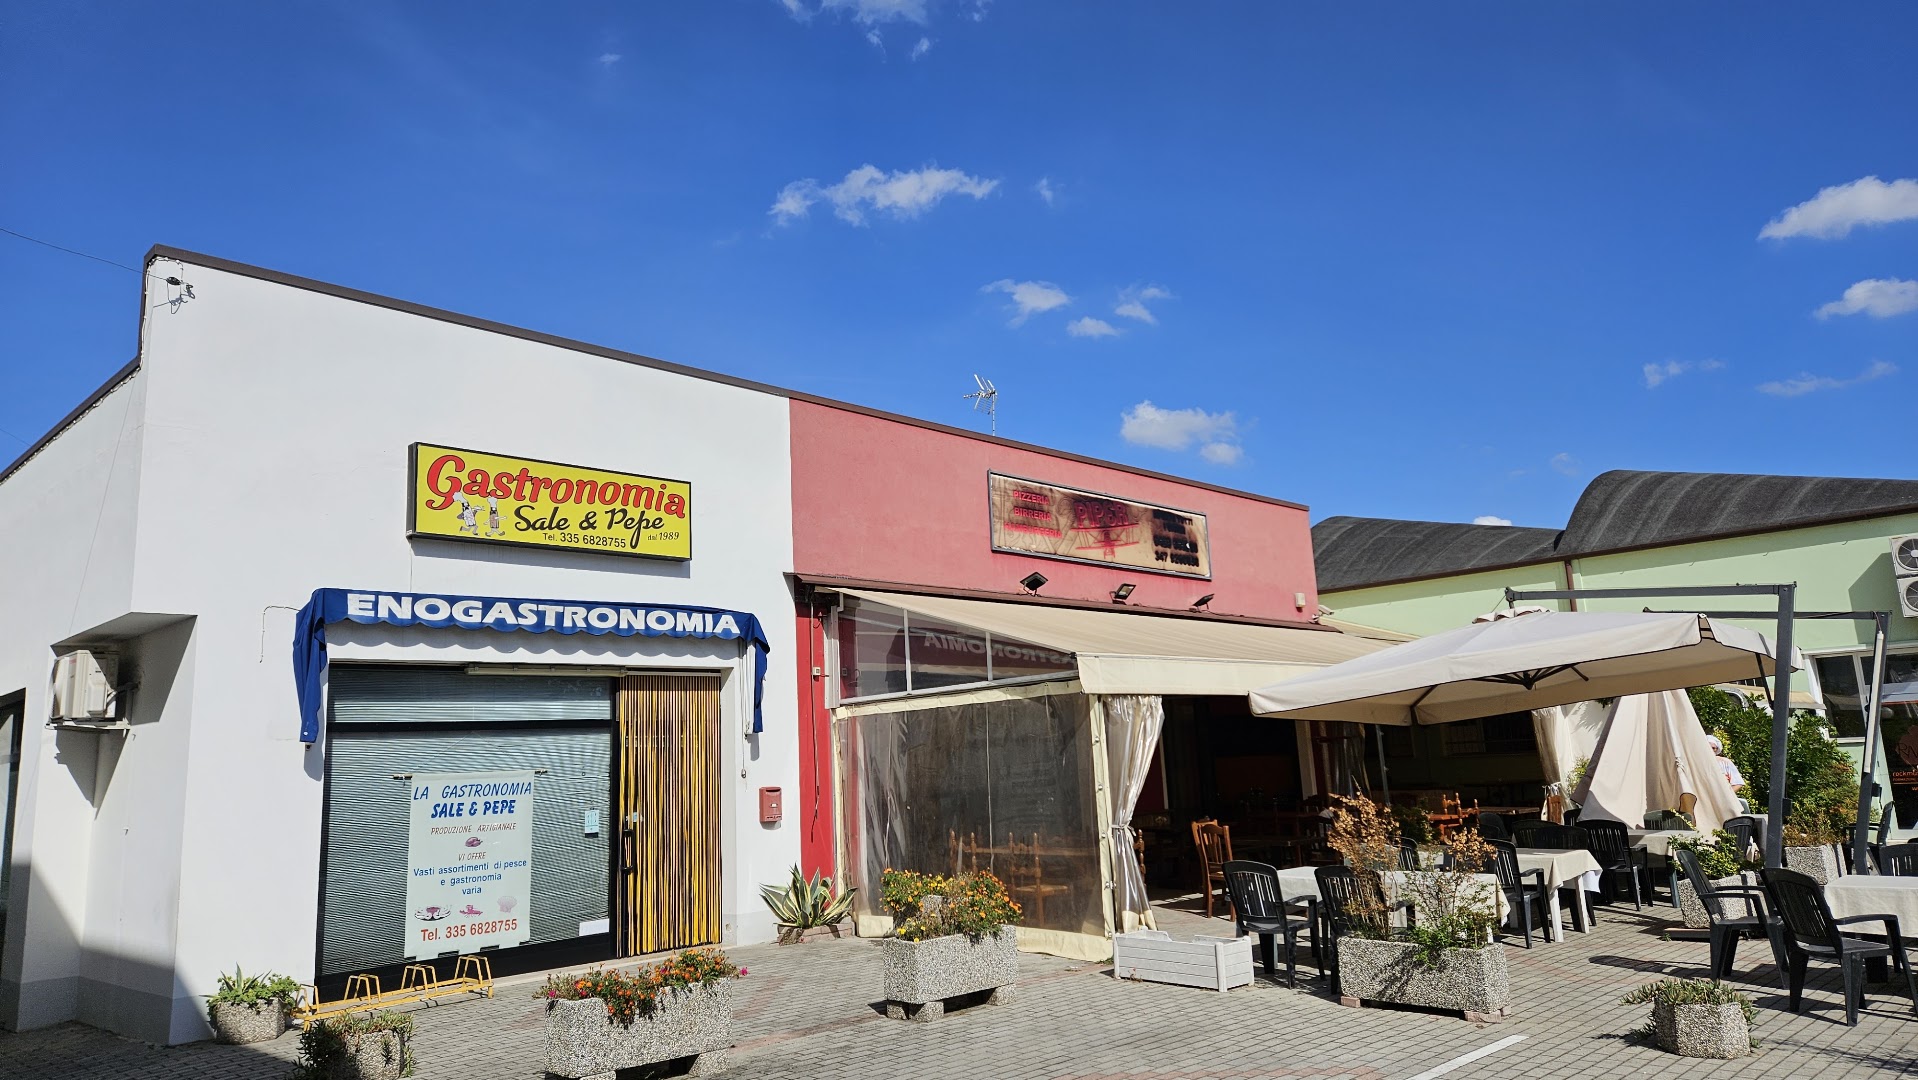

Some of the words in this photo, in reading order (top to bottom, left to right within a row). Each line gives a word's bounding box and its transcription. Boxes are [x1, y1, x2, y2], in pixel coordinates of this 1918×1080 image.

[425, 454, 686, 519] Gastronomia
[1013, 490, 1050, 505] PIZZERIA
[1013, 506, 1052, 521] BIRRERIA
[514, 505, 570, 532] Sale
[578, 510, 597, 531] &
[604, 507, 665, 549] Pepe
[543, 533, 557, 542] Tel.
[560, 532, 579, 543] 335
[583, 534, 626, 548] 6828755
[658, 531, 680, 541] 1989
[346, 593, 741, 635] ENOGASTRONOMIA
[413, 786, 429, 801] LA
[442, 782, 532, 799] GASTRONOMIA
[430, 802, 464, 819] SALE
[468, 801, 478, 817] &
[483, 800, 516, 815] PEPE
[431, 825, 472, 836] PRODUZIONE
[477, 822, 516, 833] ARTIGIANALE
[458, 853, 465, 862] VI
[467, 852, 487, 861] OFFRE
[413, 867, 435, 877] Vasti
[438, 862, 489, 875] assortimenti
[493, 861, 502, 870] di
[503, 859, 527, 871] pesce
[450, 873, 502, 887] gastronomia
[462, 886, 482, 895] varia
[420, 928, 441, 942] Tel.
[445, 924, 466, 939] 335
[470, 919, 518, 936] 6828755
